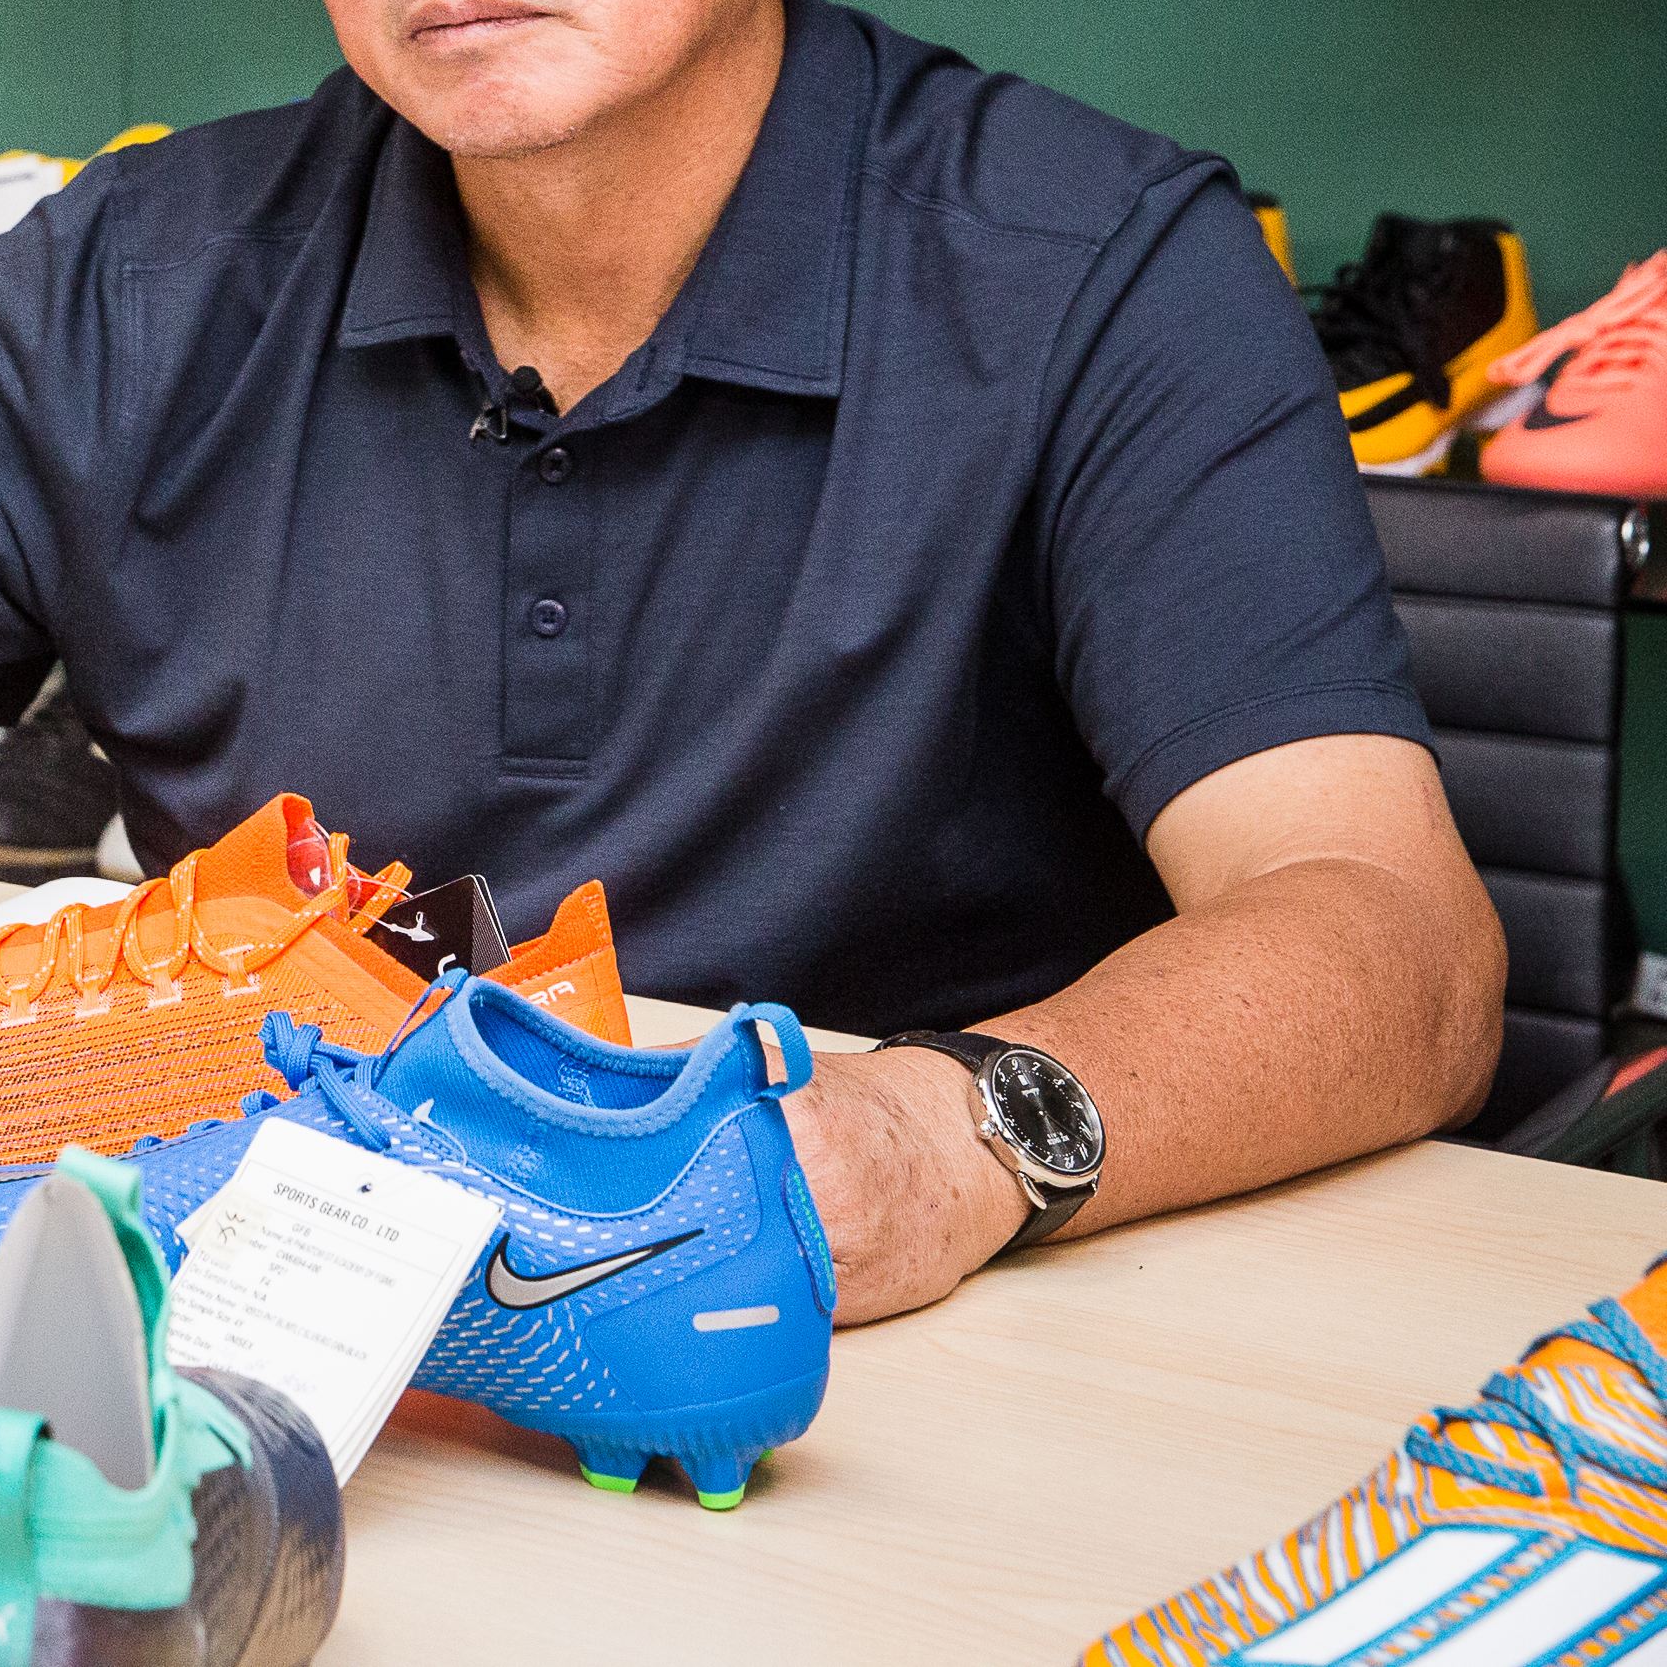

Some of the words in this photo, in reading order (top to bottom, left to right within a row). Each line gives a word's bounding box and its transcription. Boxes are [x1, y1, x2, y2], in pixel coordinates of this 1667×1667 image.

[528, 981, 576, 1007] RA
[273, 1183, 318, 1209] SPORTS
[319, 1201, 350, 1222] GEAR
[376, 1225, 399, 1242] LTD
[292, 1223, 311, 1237] GFB
[268, 1262, 287, 1275] SP21
[259, 1276, 271, 1286] F4
[181, 1280, 213, 1300] Colorway
[215, 1294, 236, 1308] Name
[188, 1299, 214, 1316] Sample
[215, 1310, 231, 1323] Size
[193, 1336, 212, 1350] Date
[225, 1334, 253, 1349] UNISEX
